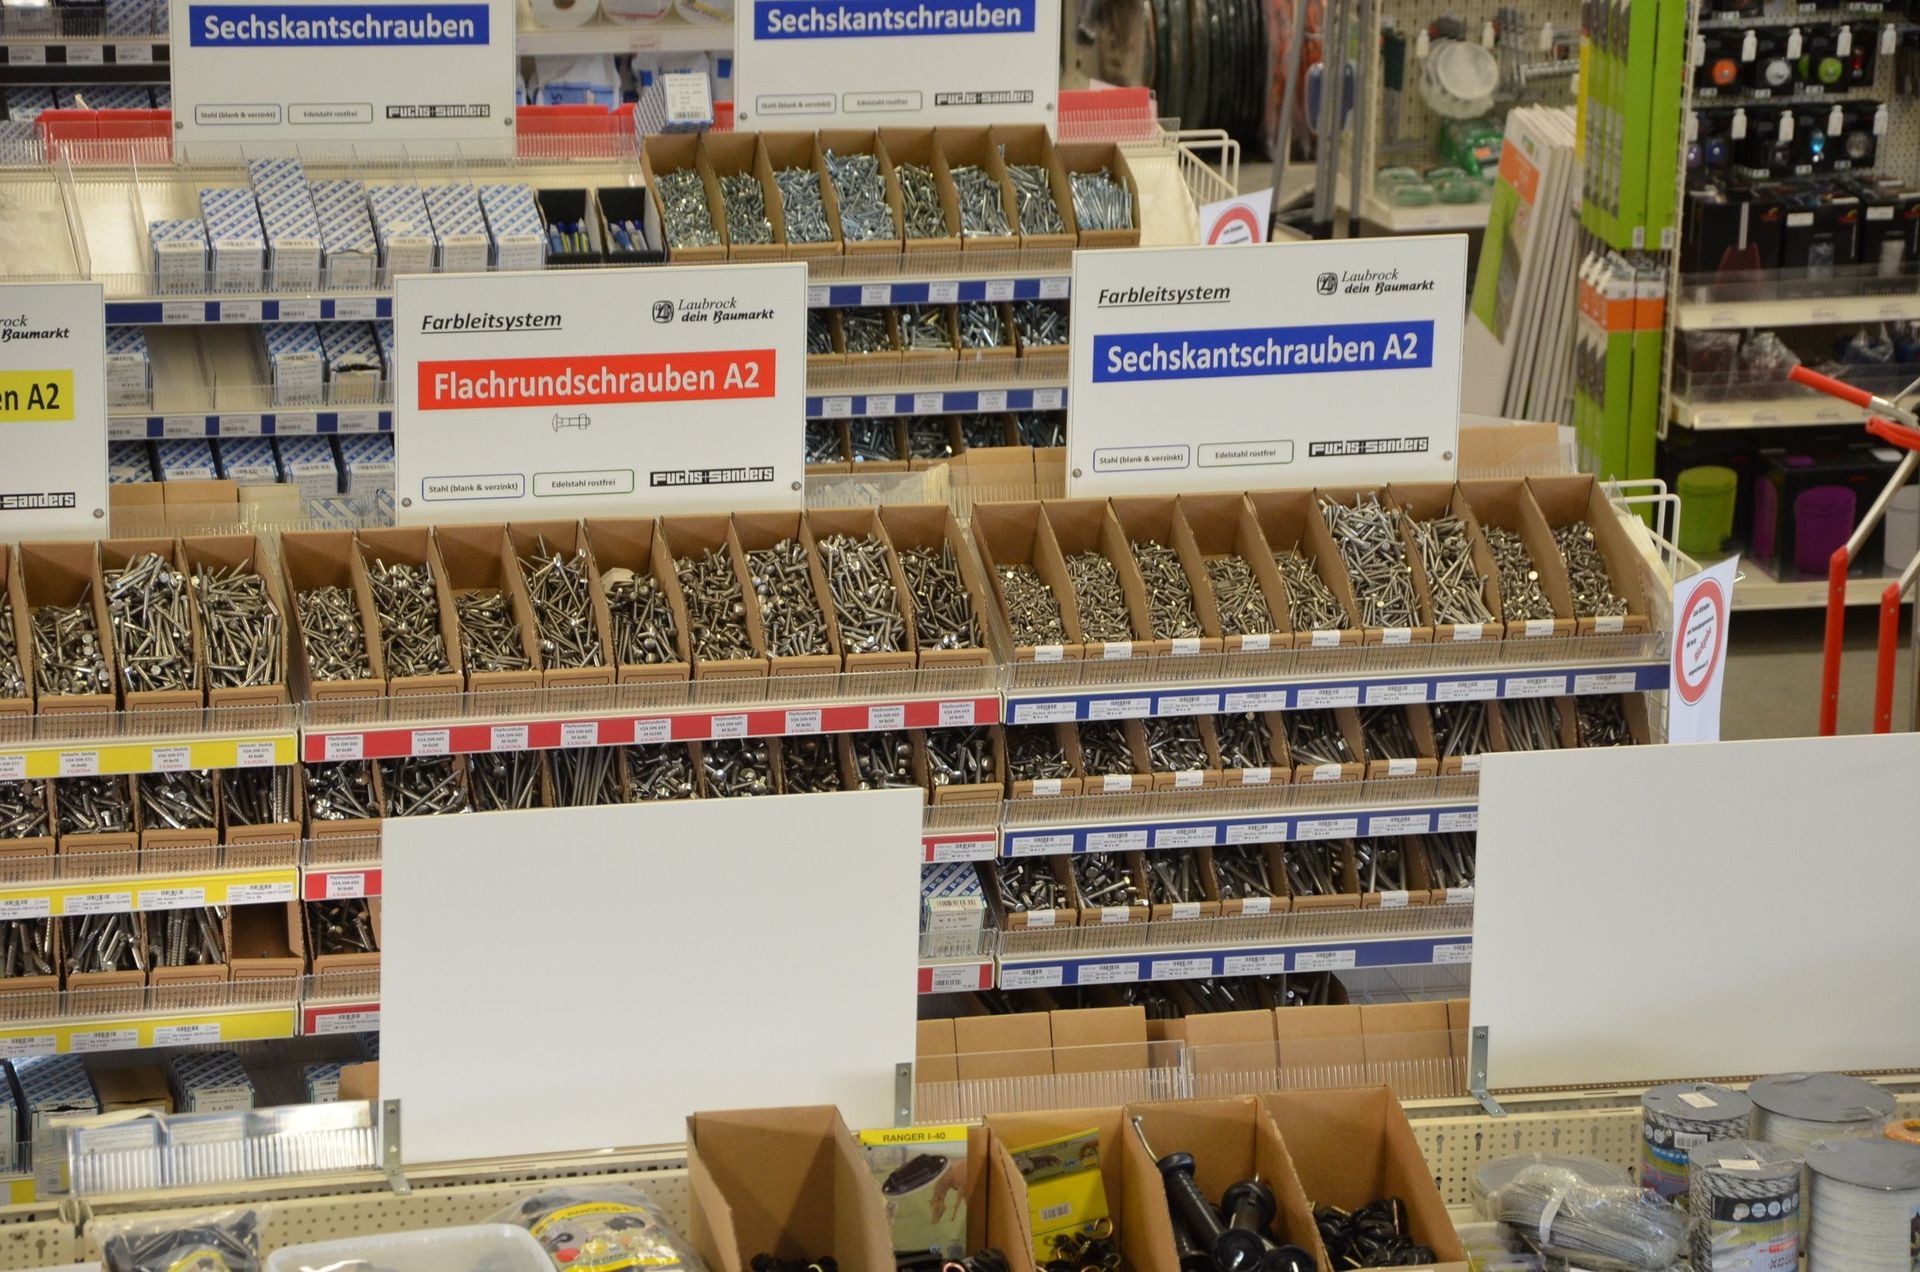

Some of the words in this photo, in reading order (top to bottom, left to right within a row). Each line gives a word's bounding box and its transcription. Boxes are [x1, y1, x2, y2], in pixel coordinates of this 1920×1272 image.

[768, 3, 1022, 34] Sechskantschrauben
[204, 13, 475, 40] Sechskantschrauben
[200, 110, 218, 119] Stahl
[303, 110, 333, 118] Edelstahl
[1342, 268, 1399, 283] Laubrock
[1344, 282, 1370, 294] dein
[1374, 279, 1435, 296] Baumarkt
[1098, 285, 1231, 306] Farbleitsystem
[678, 296, 738, 311] Laubrock
[421, 312, 562, 332] Farbleitsystem
[681, 309, 708, 323] dein
[713, 308, 775, 324] Baumarkt
[2, 328, 70, 342] Baumarkt
[1107, 334, 1376, 374] Sechskantschrauben
[1382, 332, 1418, 361] A2
[434, 364, 715, 400] Flachrundschrauben
[723, 362, 760, 389] A2
[27, 382, 60, 411] A2
[1099, 456, 1119, 465] Stahl
[1119, 455, 1143, 466] (blank
[1144, 455, 1150, 463] &
[1151, 453, 1184, 464] verzinkt)
[1214, 450, 1250, 459] Edelstahl
[1250, 448, 1277, 458] rostfrei
[428, 483, 449, 493] Stahl
[449, 482, 475, 494] (blank
[476, 483, 483, 492] &
[484, 482, 518, 493] verzinkt)
[551, 479, 588, 488] Edelstahl
[588, 478, 616, 488] rostfrei
[883, 1133, 925, 1143] RANGER
